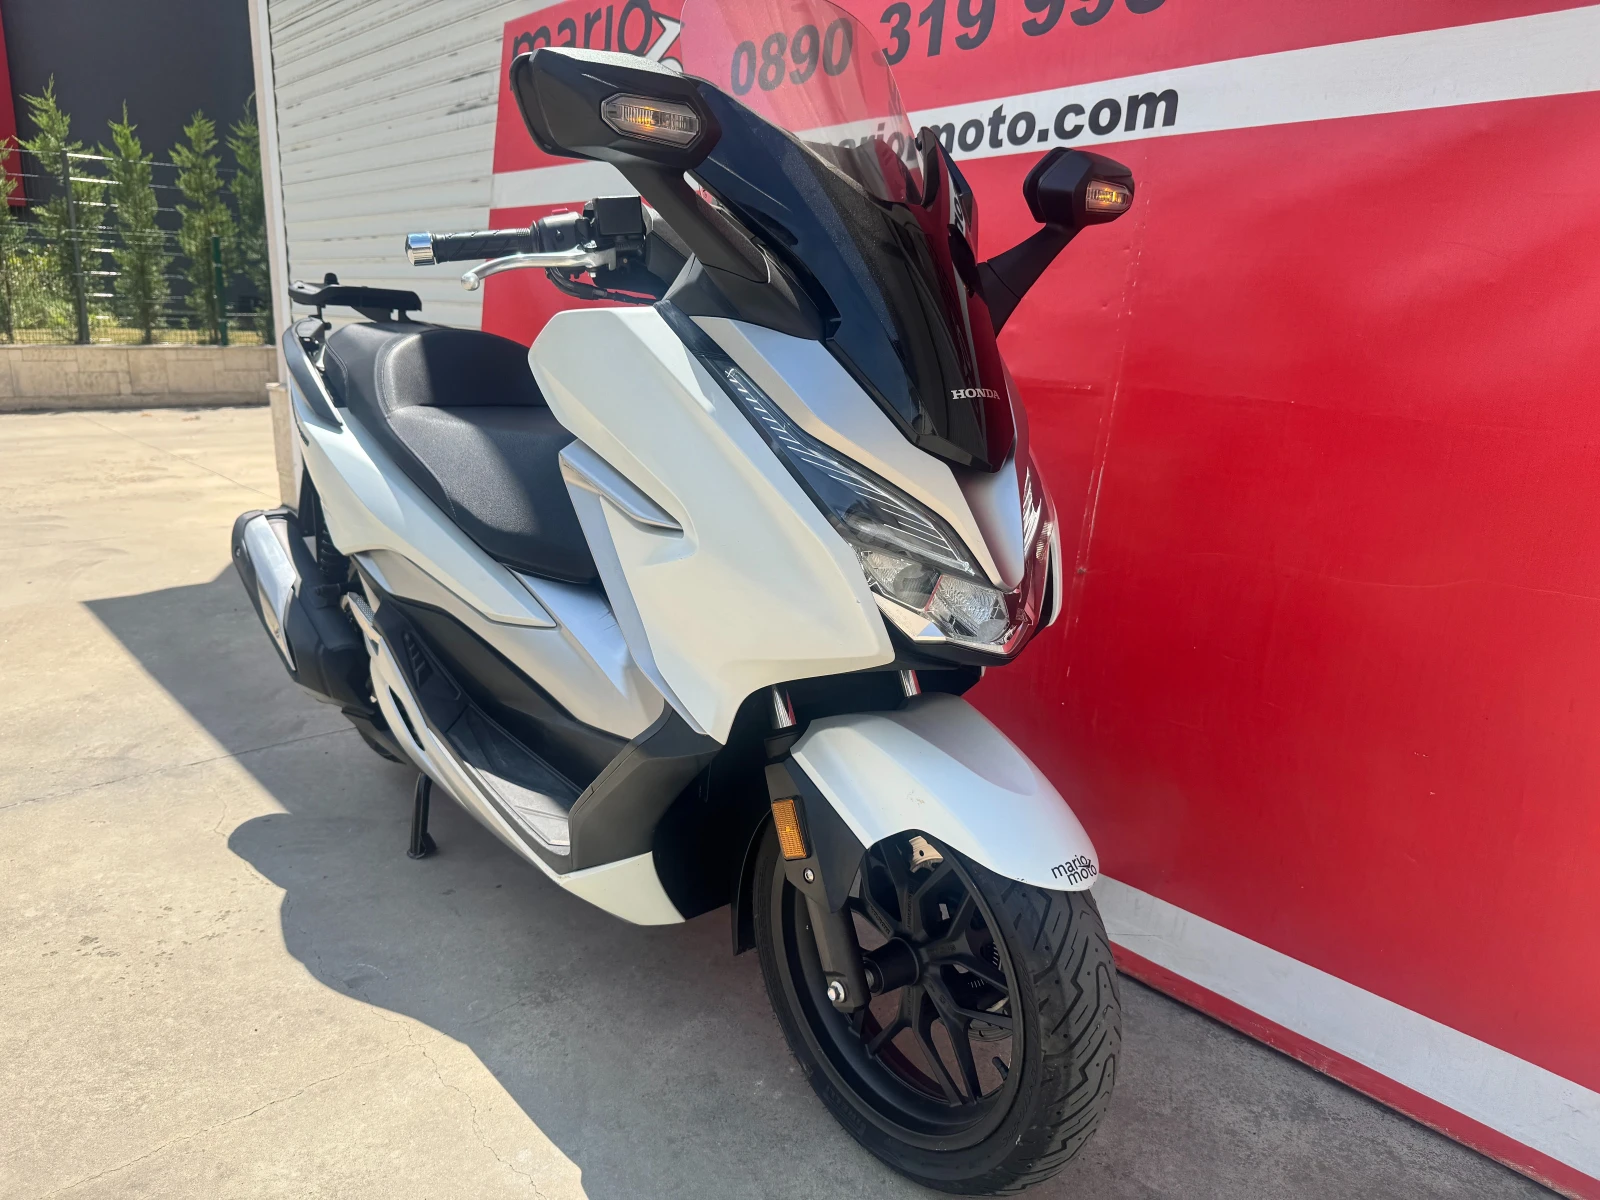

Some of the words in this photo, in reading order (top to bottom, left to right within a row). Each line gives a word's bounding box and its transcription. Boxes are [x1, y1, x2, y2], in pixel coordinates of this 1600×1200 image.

[731, 17, 853, 96] 0890
[874, 0, 996, 67] 319
[817, 88, 1179, 163] iomoto.com
[951, 387, 1000, 400] HONDA
[1051, 854, 1088, 879] mario
[1067, 864, 1097, 885] moto
